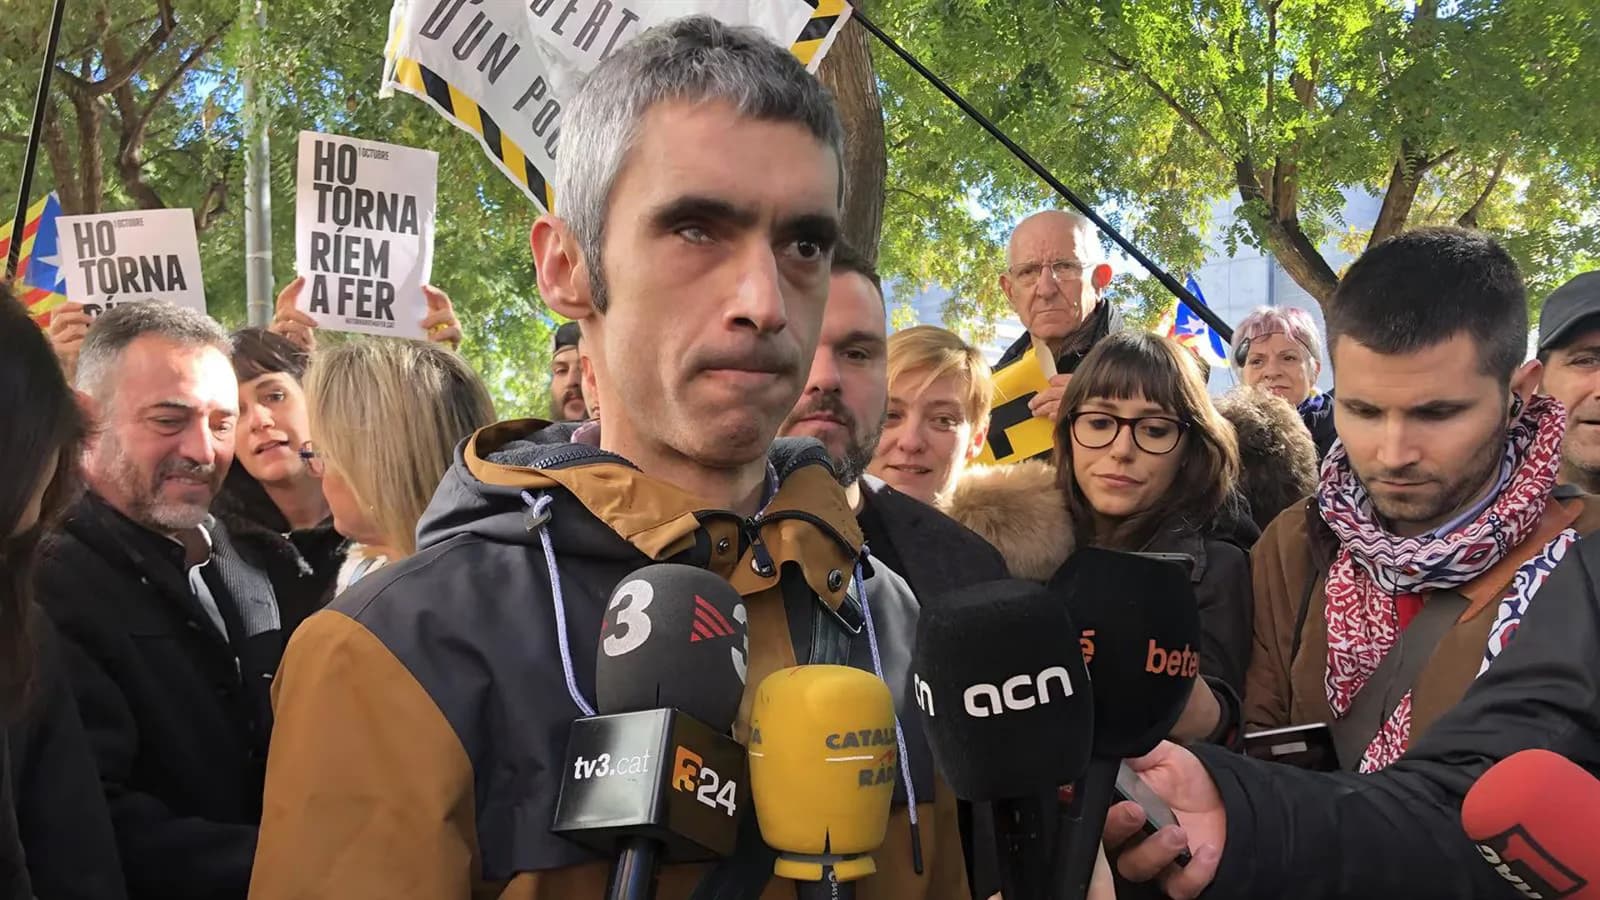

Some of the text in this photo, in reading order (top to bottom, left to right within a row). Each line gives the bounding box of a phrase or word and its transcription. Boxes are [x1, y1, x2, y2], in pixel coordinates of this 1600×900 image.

[314, 140, 358, 185] HO
[313, 182, 419, 235] TORNA
[73, 220, 116, 259] HO
[310, 227, 390, 279] RÍEM
[79, 254, 187, 296] TORNA
[309, 274, 395, 320] A FER
[603, 579, 654, 657] 3
[1145, 639, 1199, 678] bete
[963, 666, 1074, 717] acn
[574, 749, 650, 779] tv3.cat
